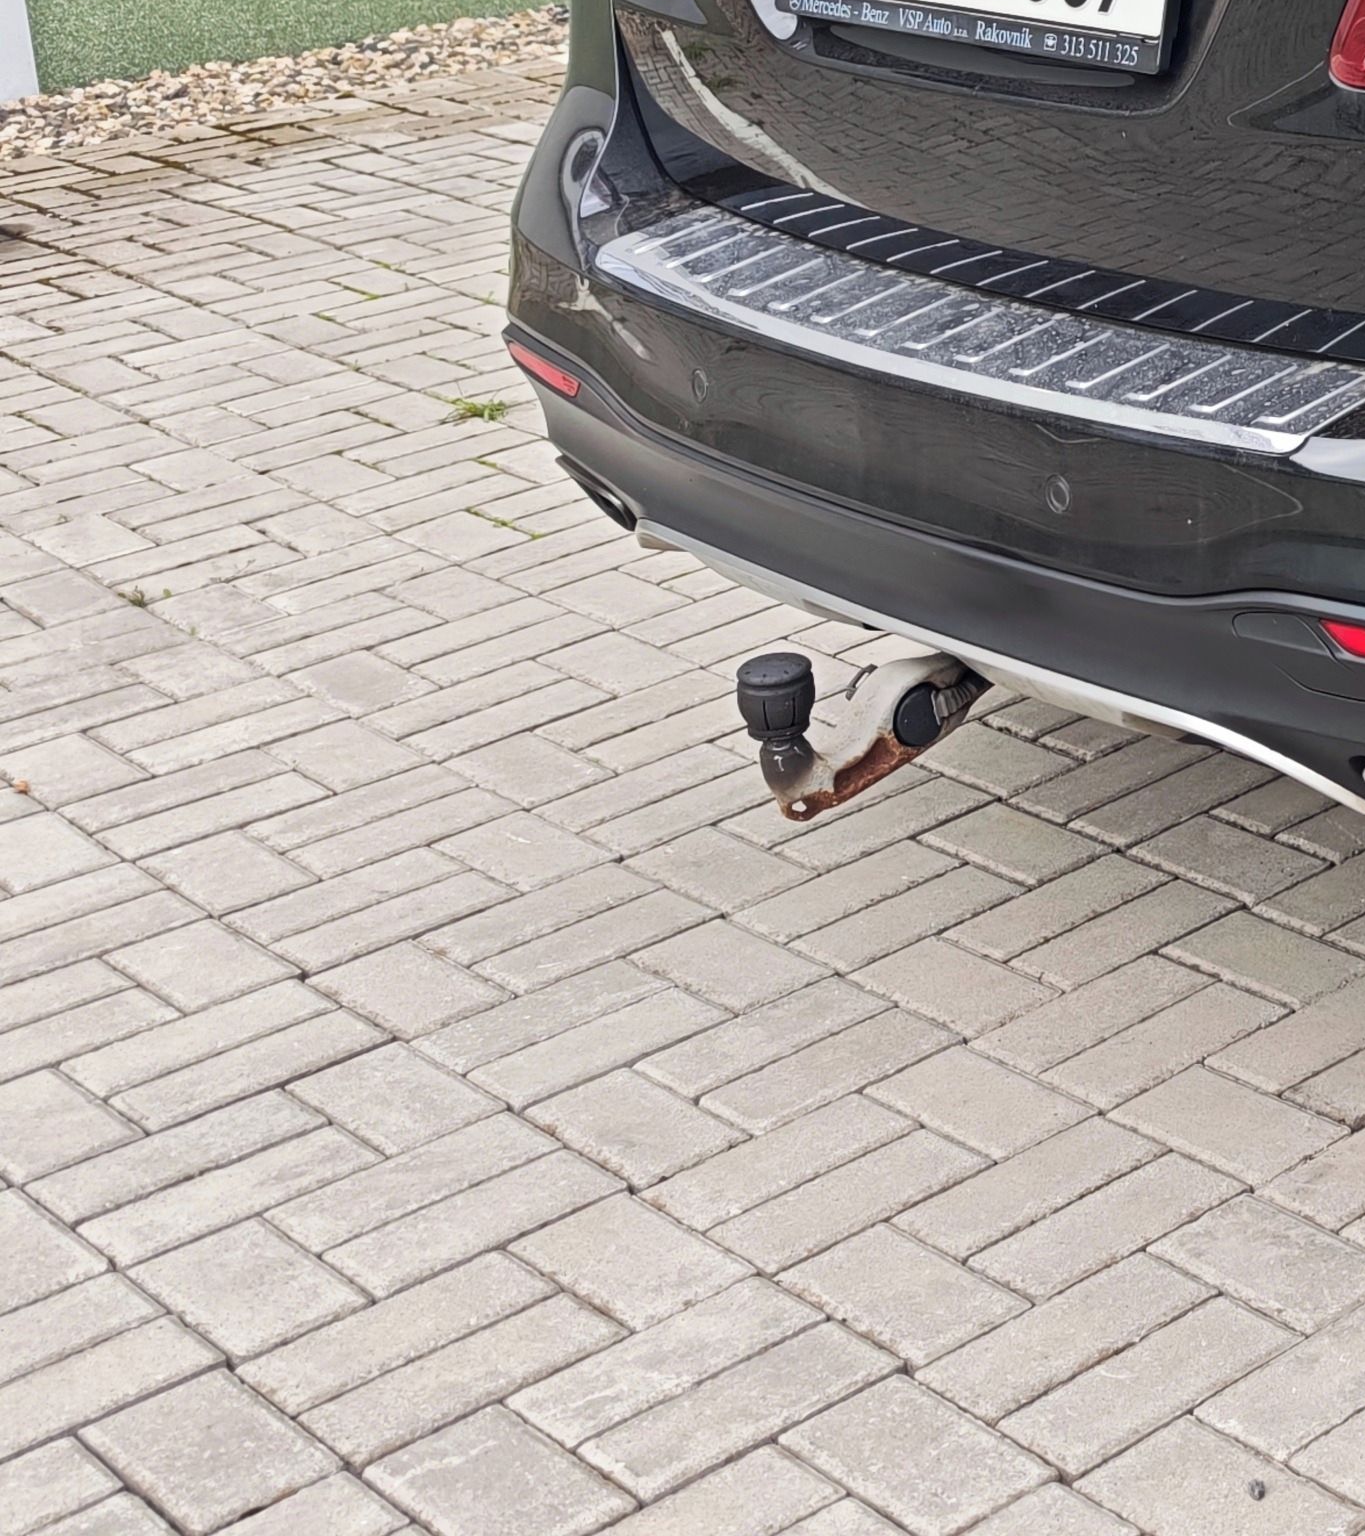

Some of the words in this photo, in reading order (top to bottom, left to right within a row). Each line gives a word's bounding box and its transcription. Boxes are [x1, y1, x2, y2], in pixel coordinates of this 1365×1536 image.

[899, 7, 923, 29] VSP
[922, 13, 951, 35] Auto
[974, 20, 1033, 49] Rakovník
[1060, 35, 1084, 58] 313
[1088, 39, 1109, 62] 511
[1113, 43, 1139, 66] 325
